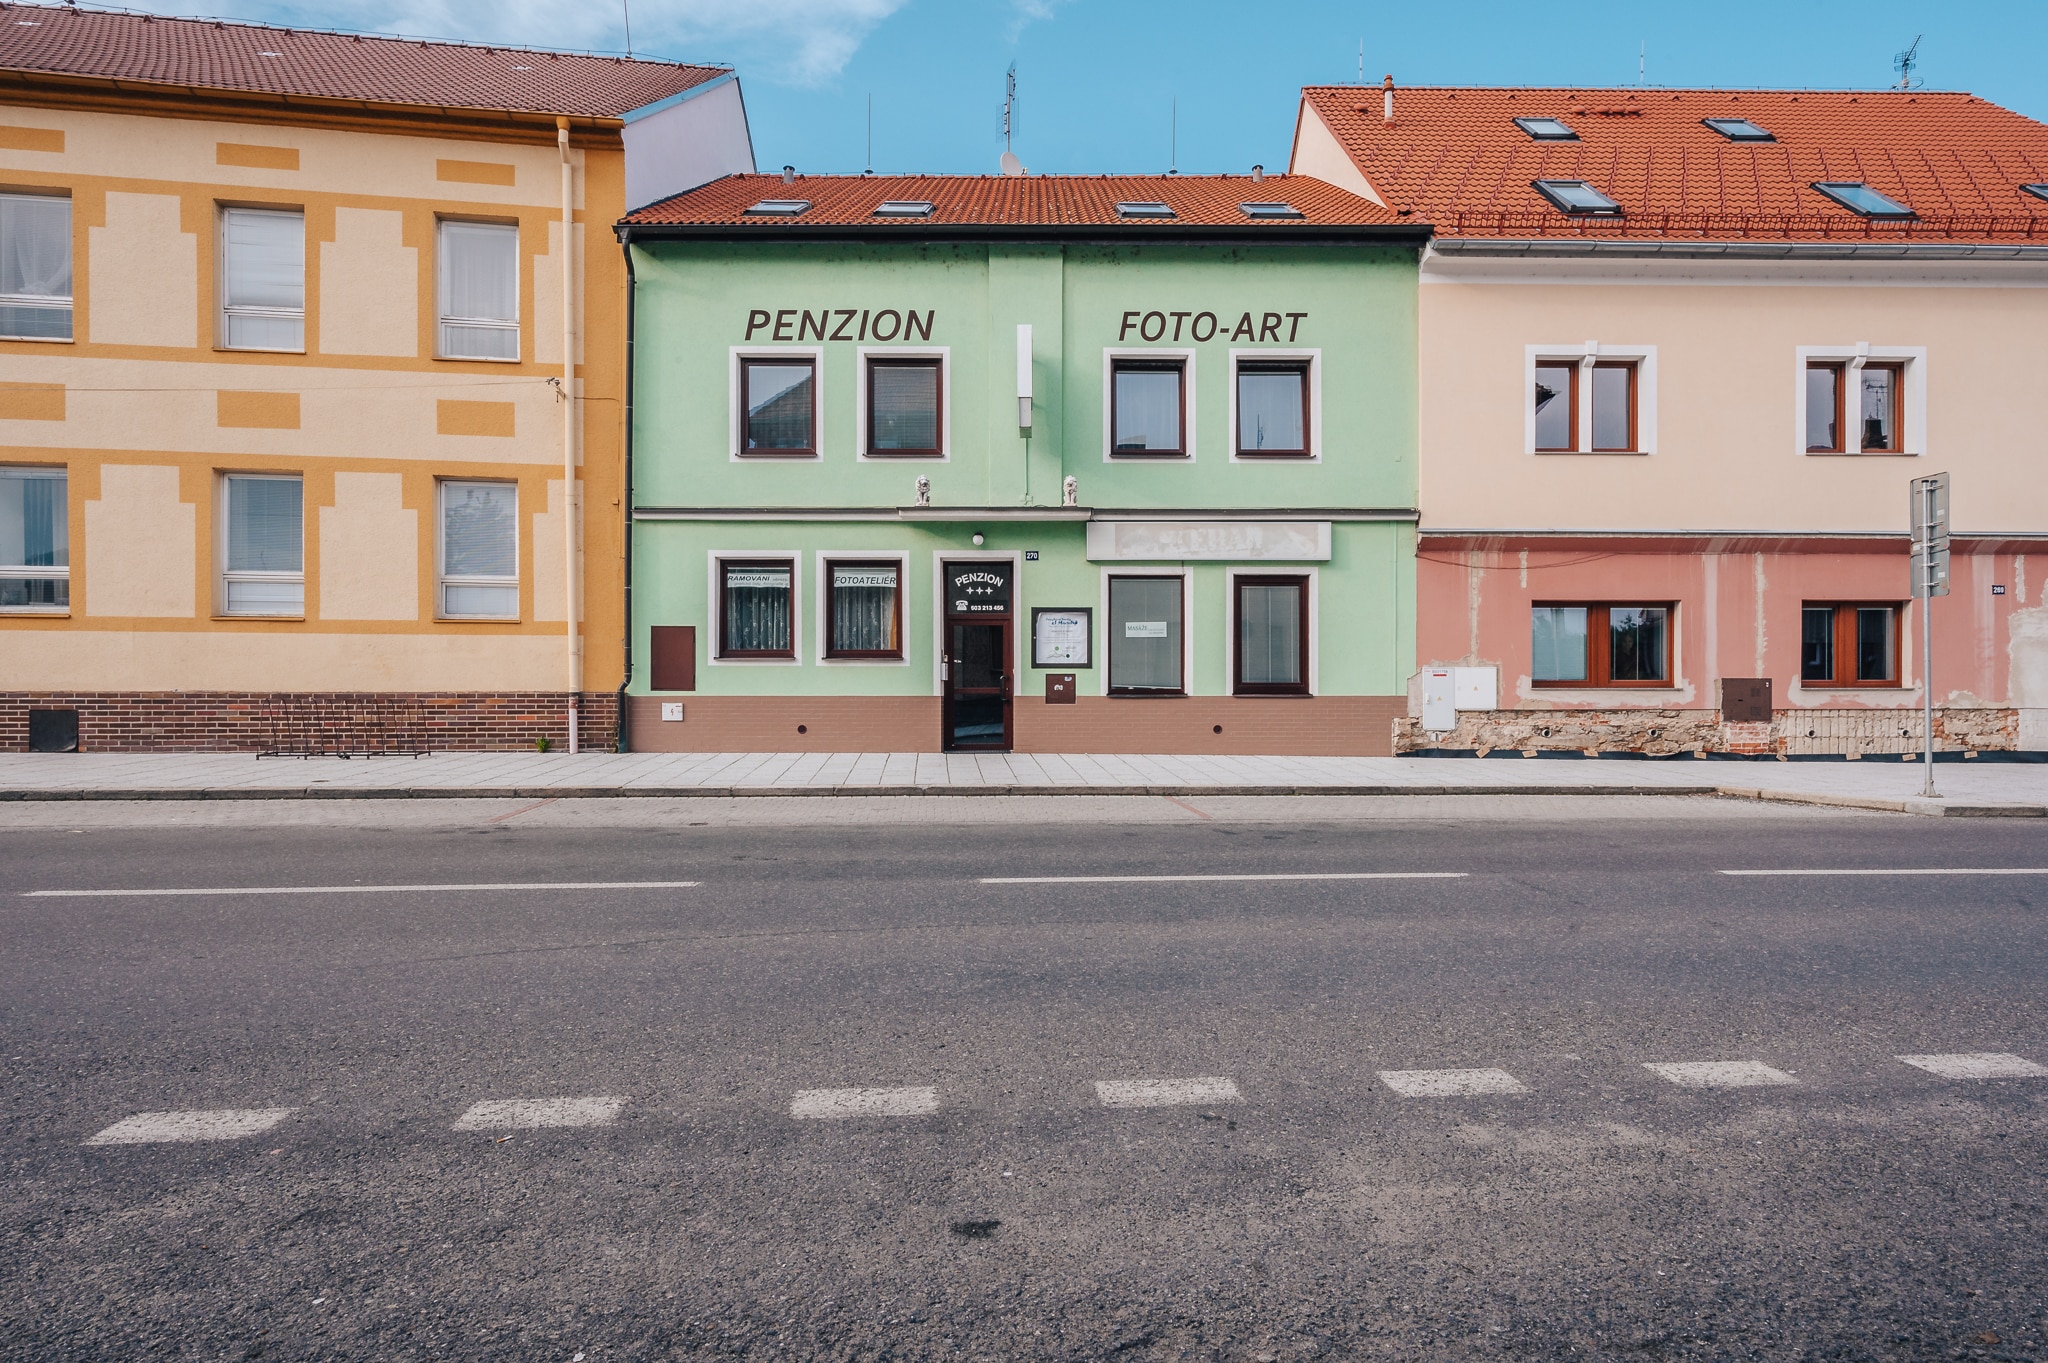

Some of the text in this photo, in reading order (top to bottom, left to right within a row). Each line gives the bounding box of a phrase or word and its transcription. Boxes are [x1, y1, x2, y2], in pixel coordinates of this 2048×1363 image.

[744, 309, 935, 341] PENZION
[1118, 311, 1308, 343] FOTO-ART
[1026, 552, 1038, 560] 270
[834, 575, 897, 585] FOTOATELIÉR
[954, 572, 1004, 587] PENZION
